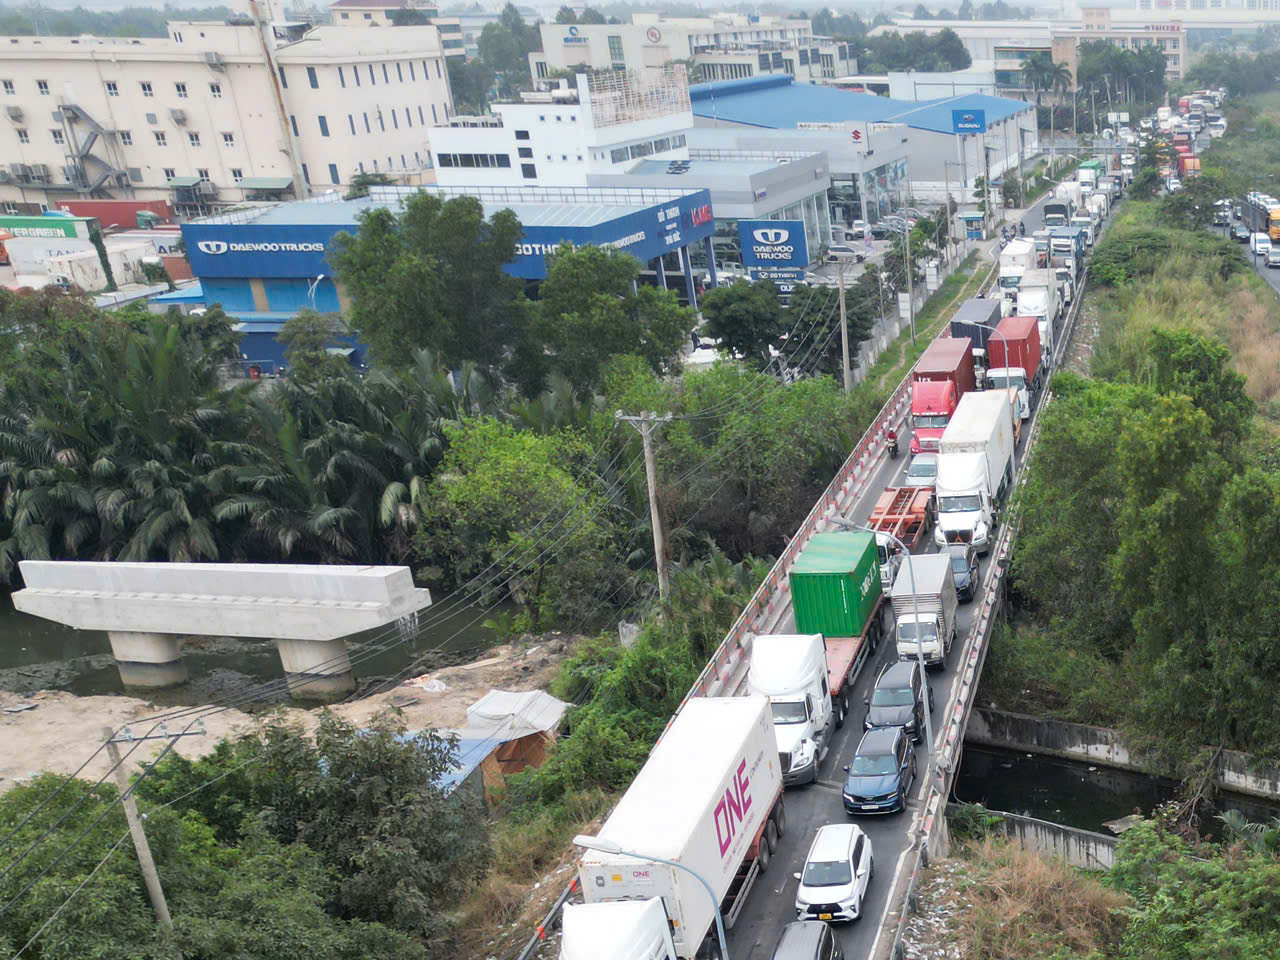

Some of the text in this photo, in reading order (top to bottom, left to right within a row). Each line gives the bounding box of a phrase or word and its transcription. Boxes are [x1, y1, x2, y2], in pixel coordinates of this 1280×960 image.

[7, 227, 65, 238] VERGREEN
[754, 252, 792, 260] TRUCKS
[713, 757, 753, 859] ONE
